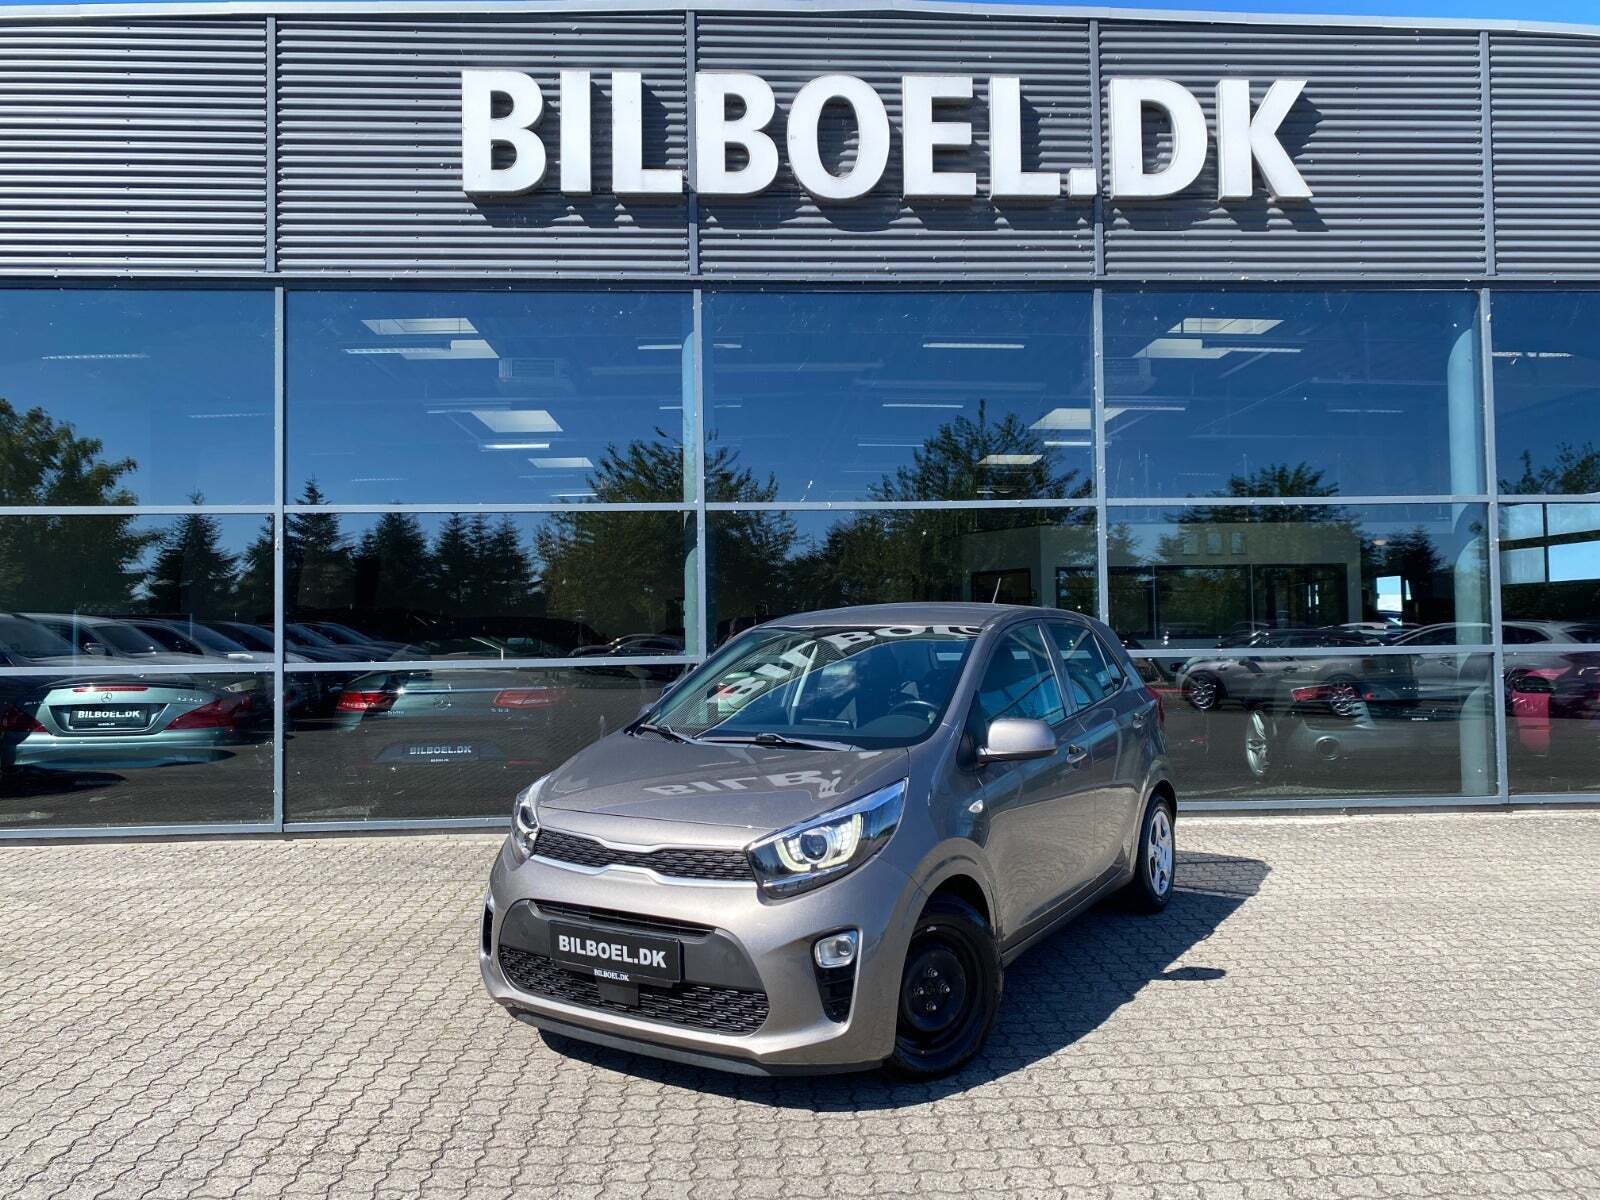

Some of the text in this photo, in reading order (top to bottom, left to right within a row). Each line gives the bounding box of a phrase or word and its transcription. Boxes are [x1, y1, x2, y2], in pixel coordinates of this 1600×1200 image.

[461, 69, 1313, 201] BILBOEL.DK
[77, 710, 140, 719] BILBOEL.DK
[558, 935, 667, 969] BILBOEL.DK
[593, 968, 630, 982] BILBOEL.DK
